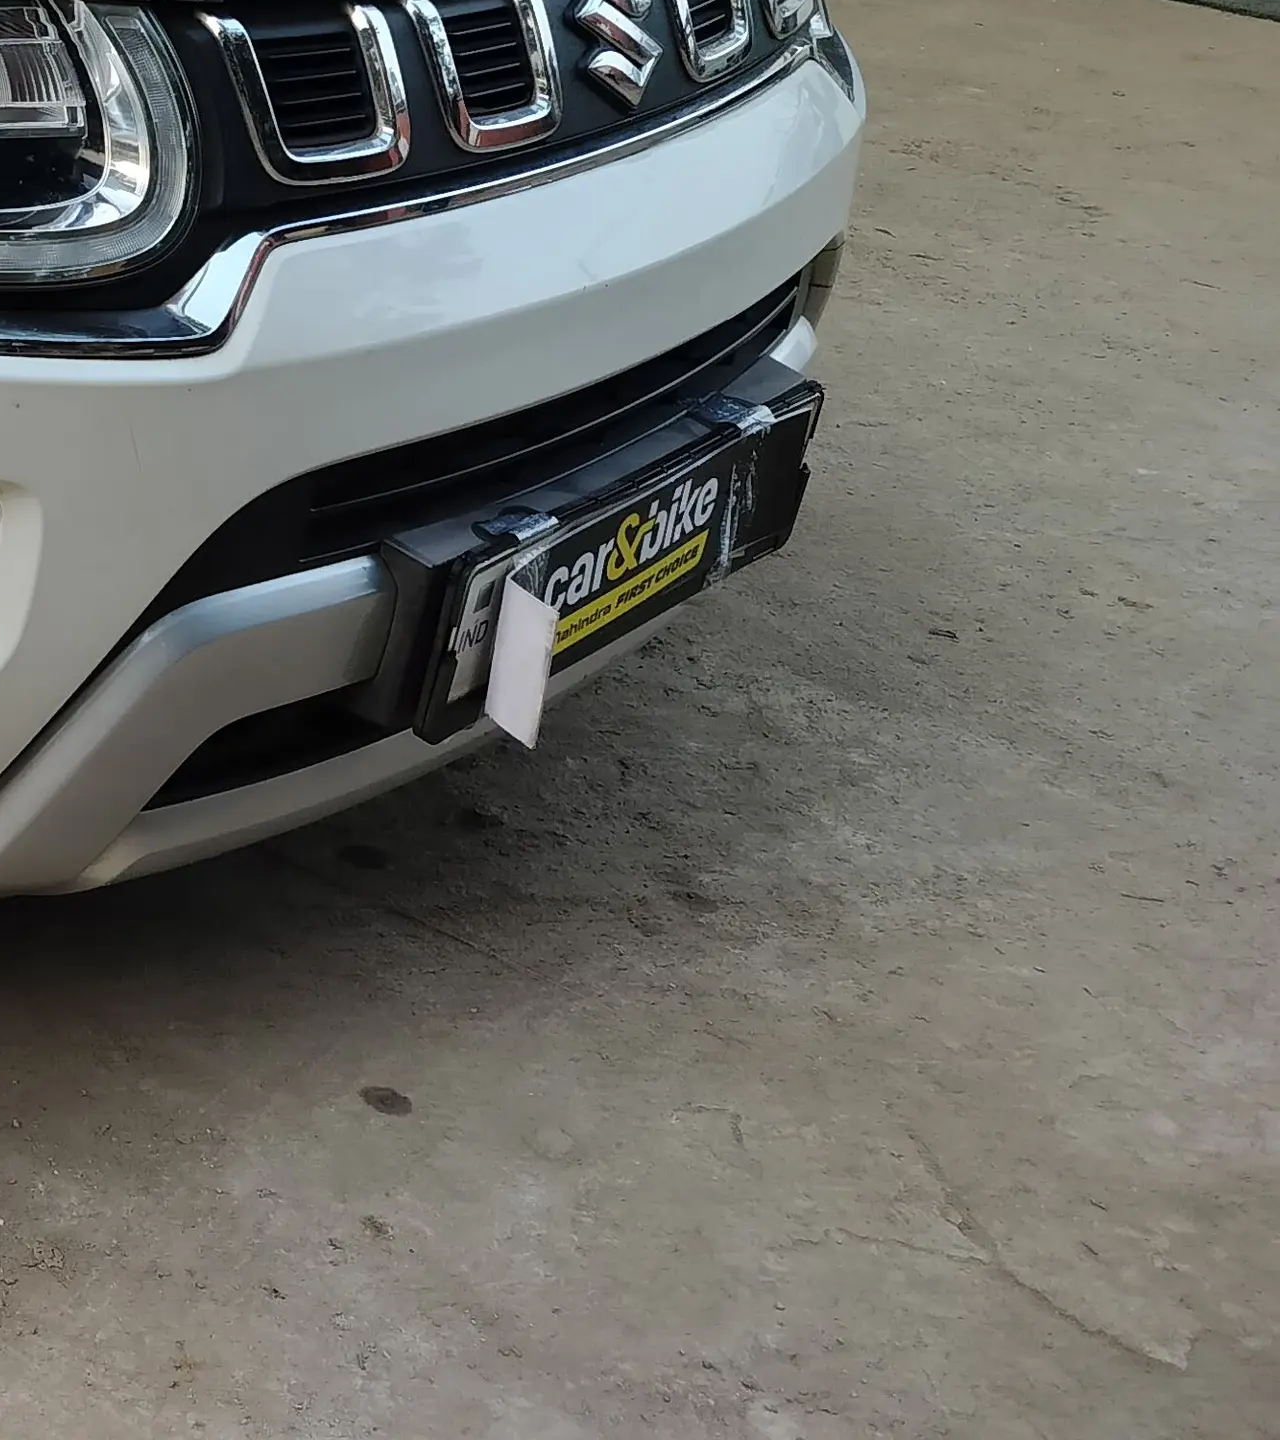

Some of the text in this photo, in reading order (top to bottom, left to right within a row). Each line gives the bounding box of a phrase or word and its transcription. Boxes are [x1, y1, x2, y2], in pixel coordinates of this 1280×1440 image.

[544, 476, 719, 612] car&bike
[615, 578, 654, 609] FIRST
[655, 544, 700, 583] CHOICE
[458, 620, 489, 654] IND
